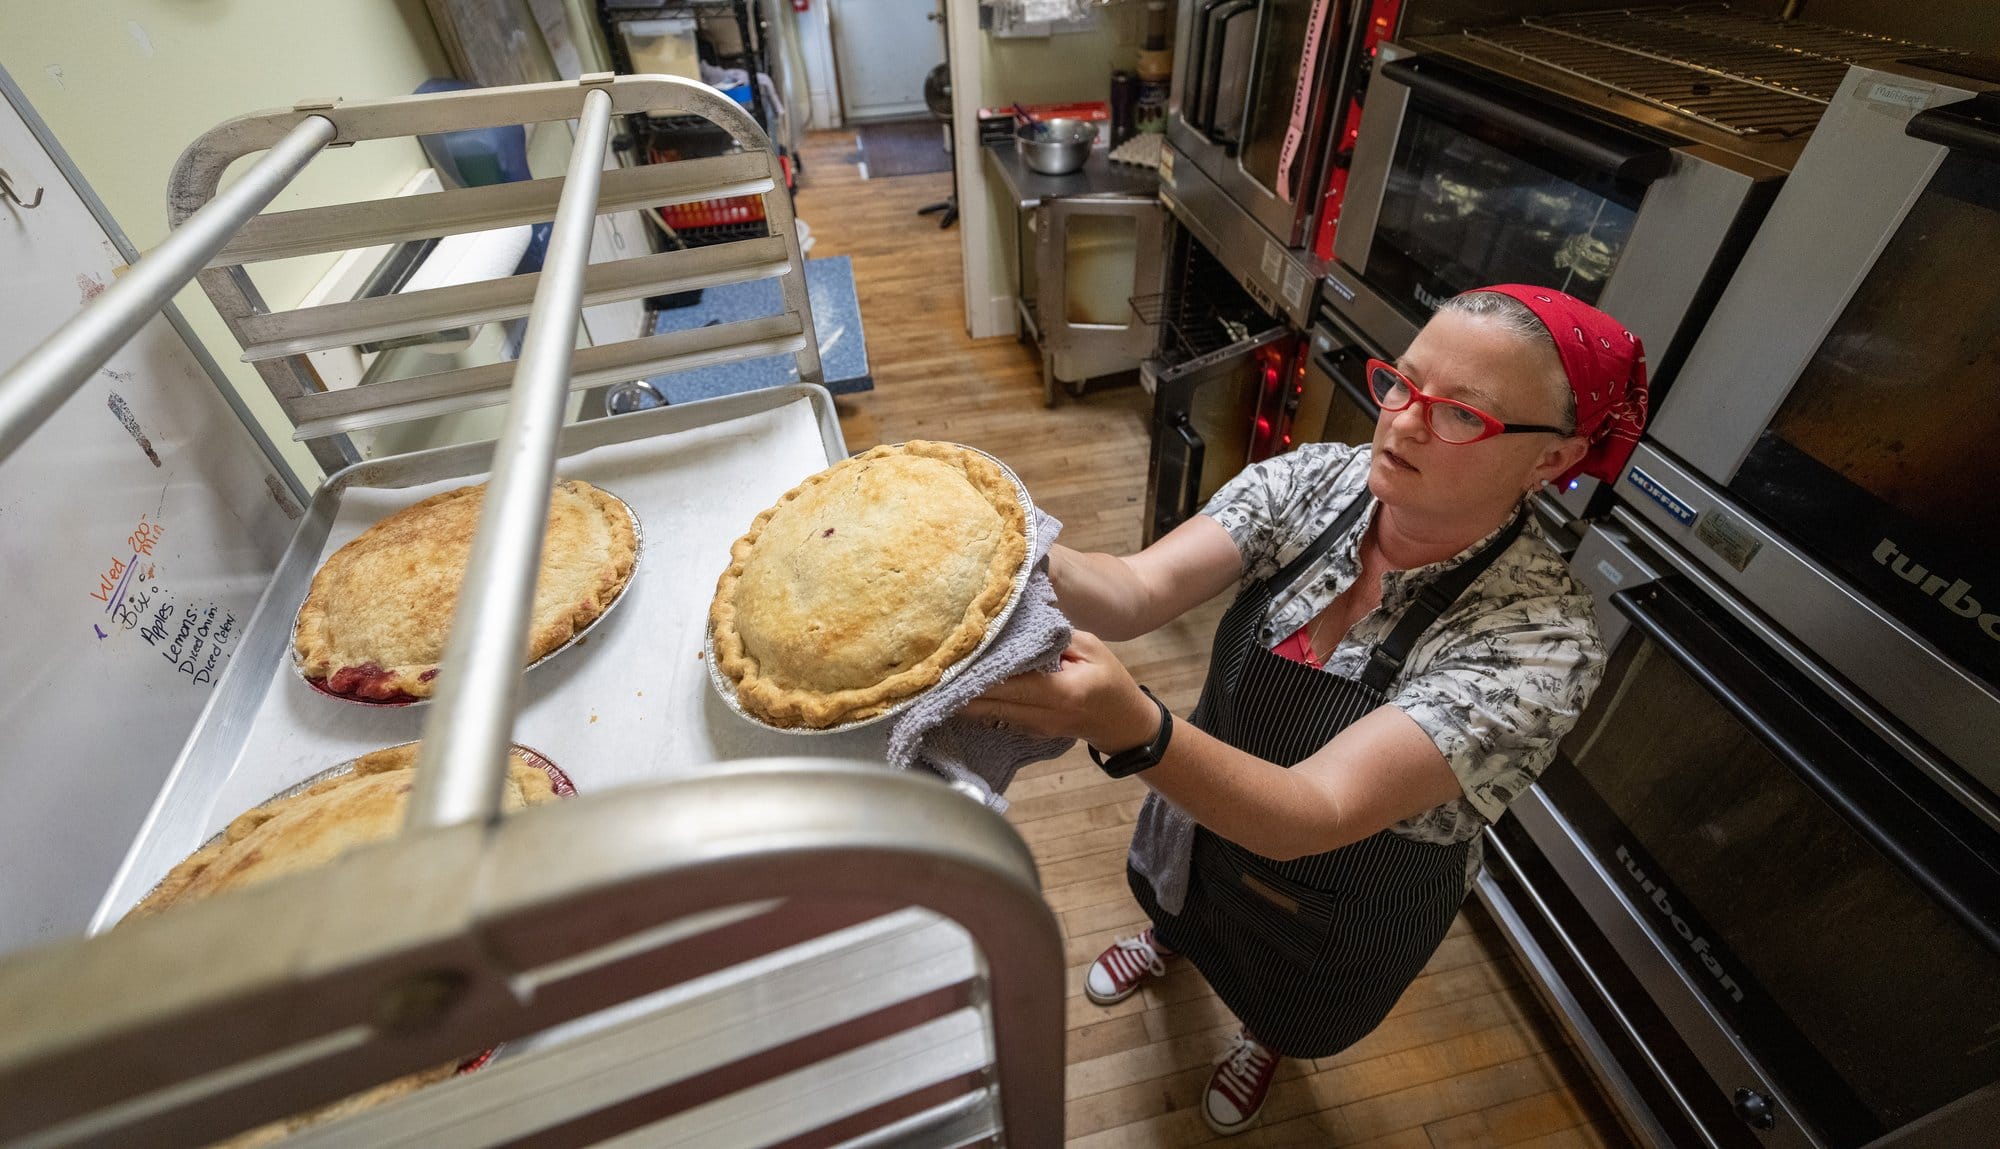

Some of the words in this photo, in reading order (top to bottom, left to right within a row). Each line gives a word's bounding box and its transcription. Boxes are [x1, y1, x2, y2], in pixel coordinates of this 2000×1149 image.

[1630, 472, 1692, 520] MOFFAT
[90, 557, 126, 601] Wed
[179, 633, 204, 675] Diced
[193, 643, 221, 685] Diced
[1616, 844, 1744, 1002] turbofan
